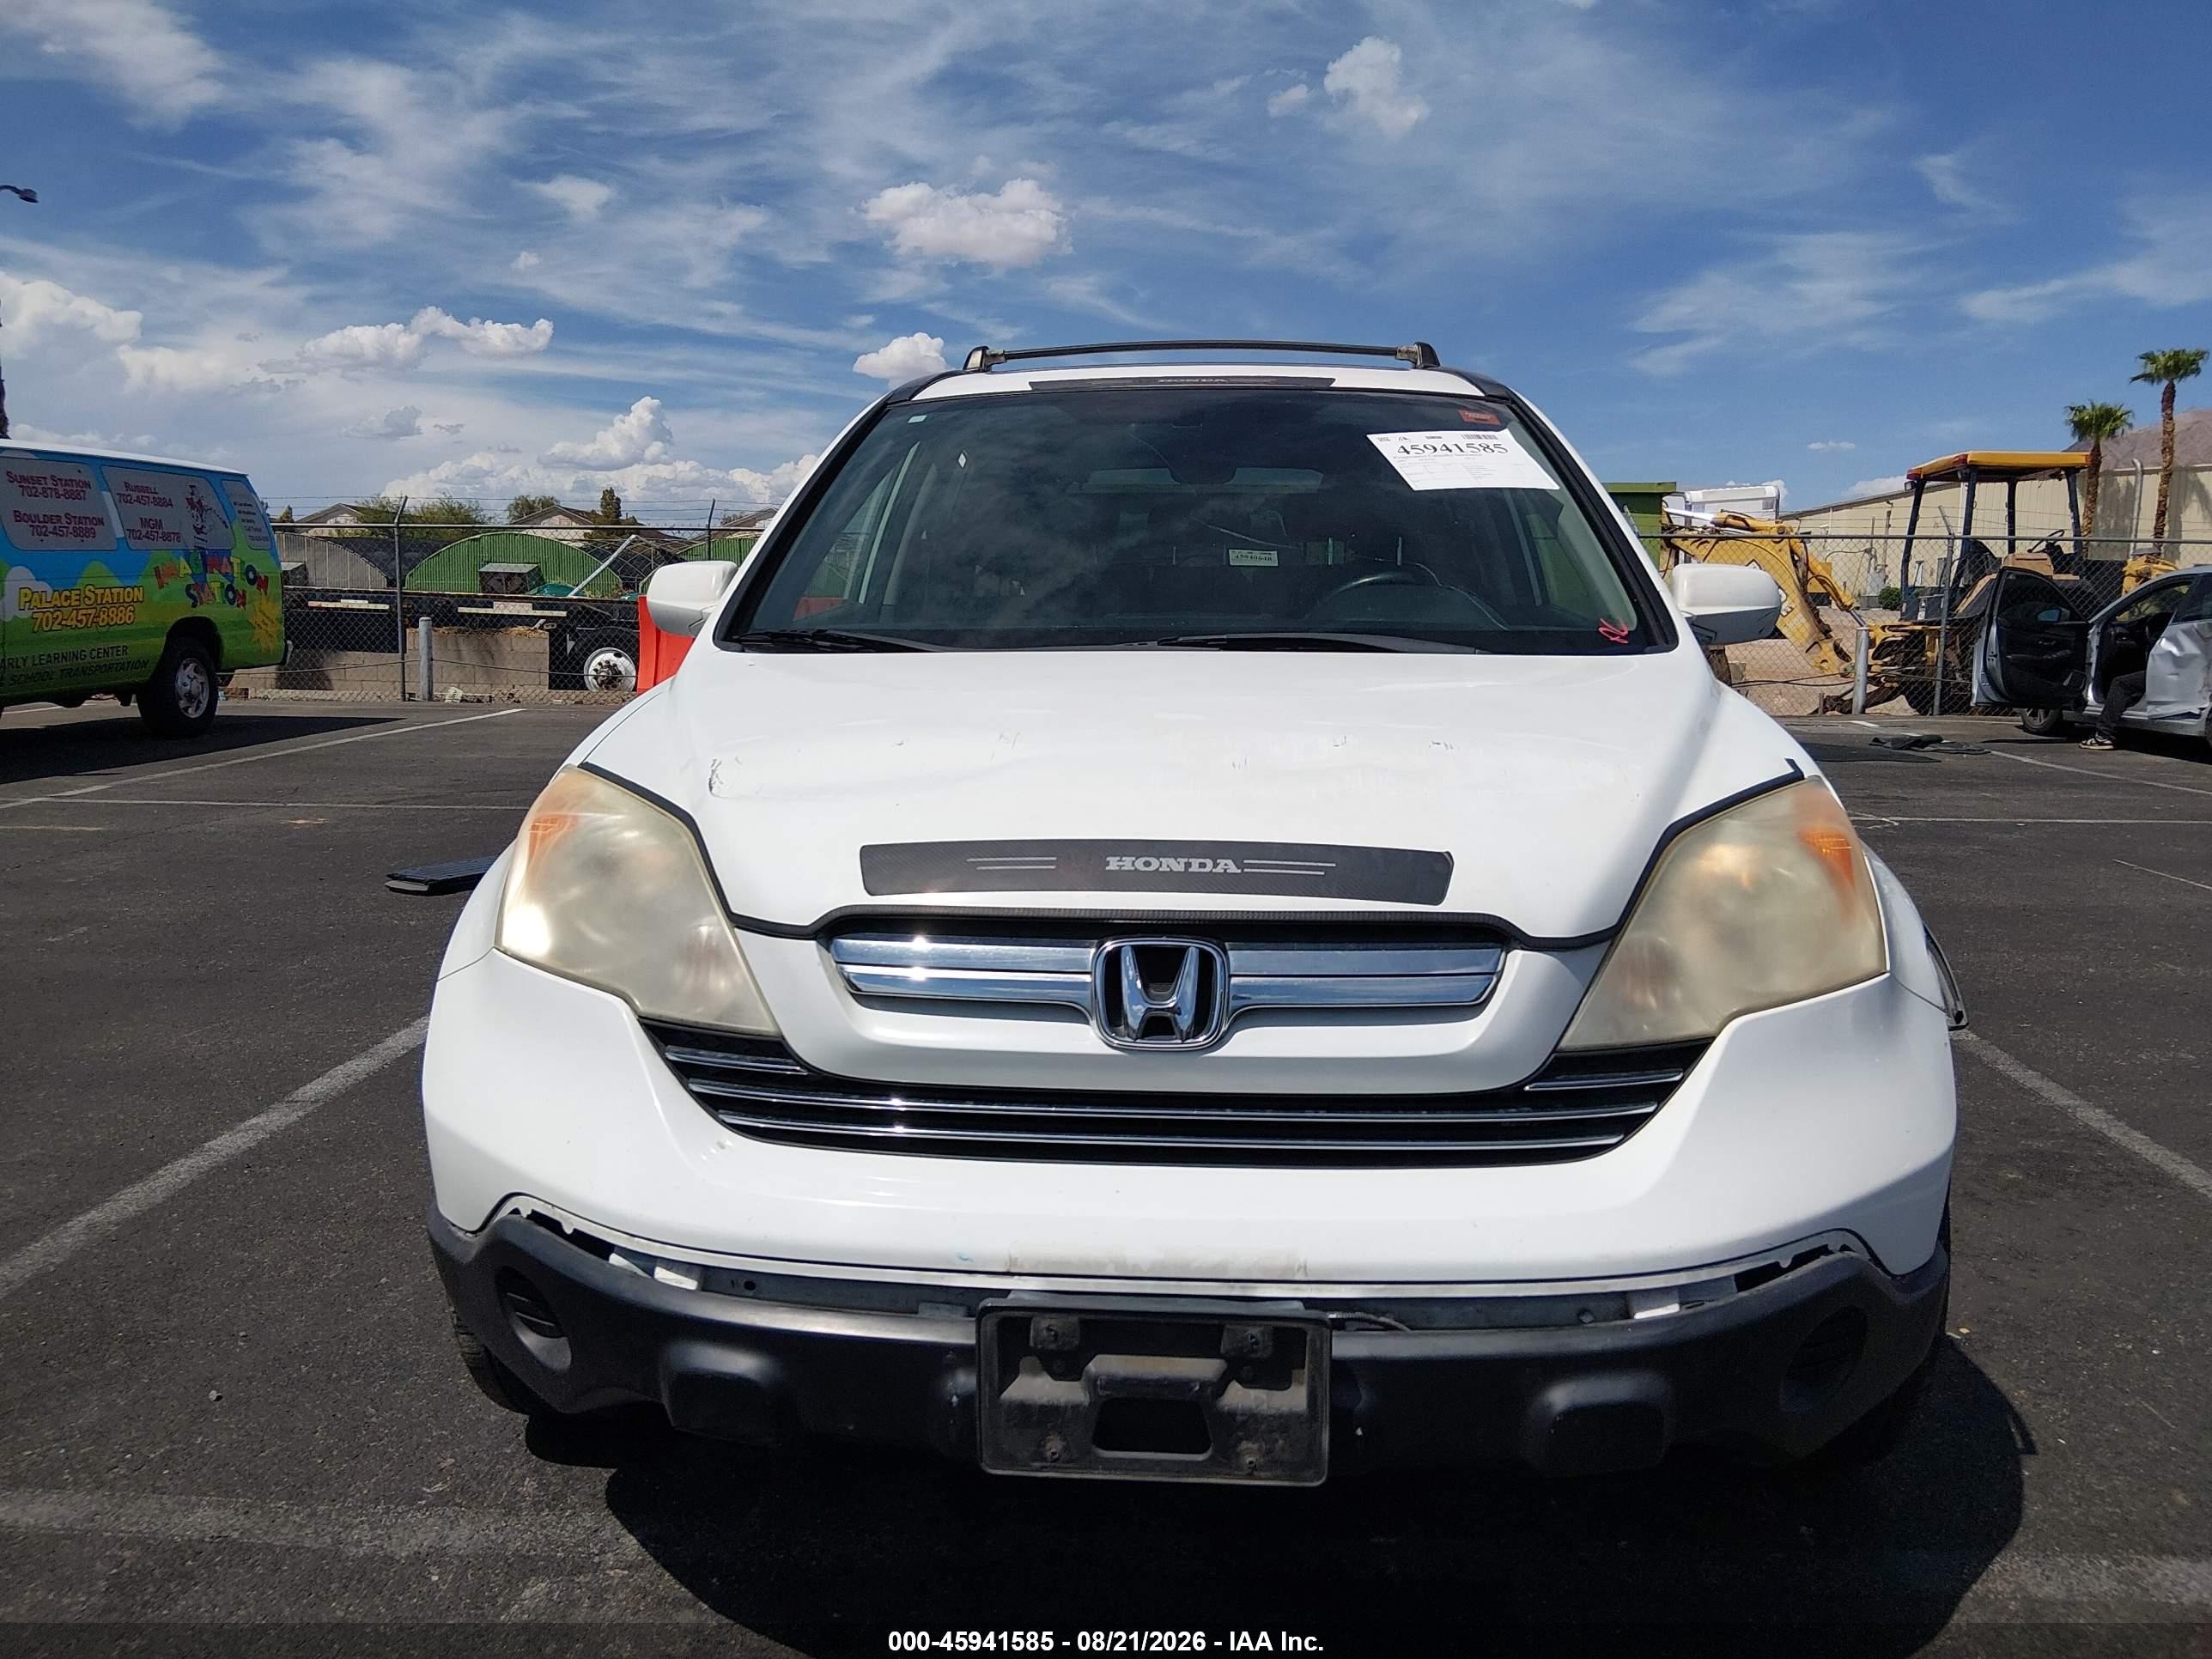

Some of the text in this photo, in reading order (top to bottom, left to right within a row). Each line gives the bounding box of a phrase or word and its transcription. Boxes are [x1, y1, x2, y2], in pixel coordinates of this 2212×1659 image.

[1397, 442, 1509, 455] 45941585
[7, 471, 92, 489] SUNSET STATION
[13, 510, 106, 527] BOULDER STATION
[139, 517, 164, 531] MGM
[19, 584, 144, 611] PALACE STATION
[185, 580, 247, 611] STATION
[32, 605, 135, 633] 702-457-8886
[32, 649, 87, 667] LEARNING
[89, 645, 129, 660] CENTER
[59, 659, 149, 680] TRANSPORTATION
[1105, 855, 1242, 874] HONDA
